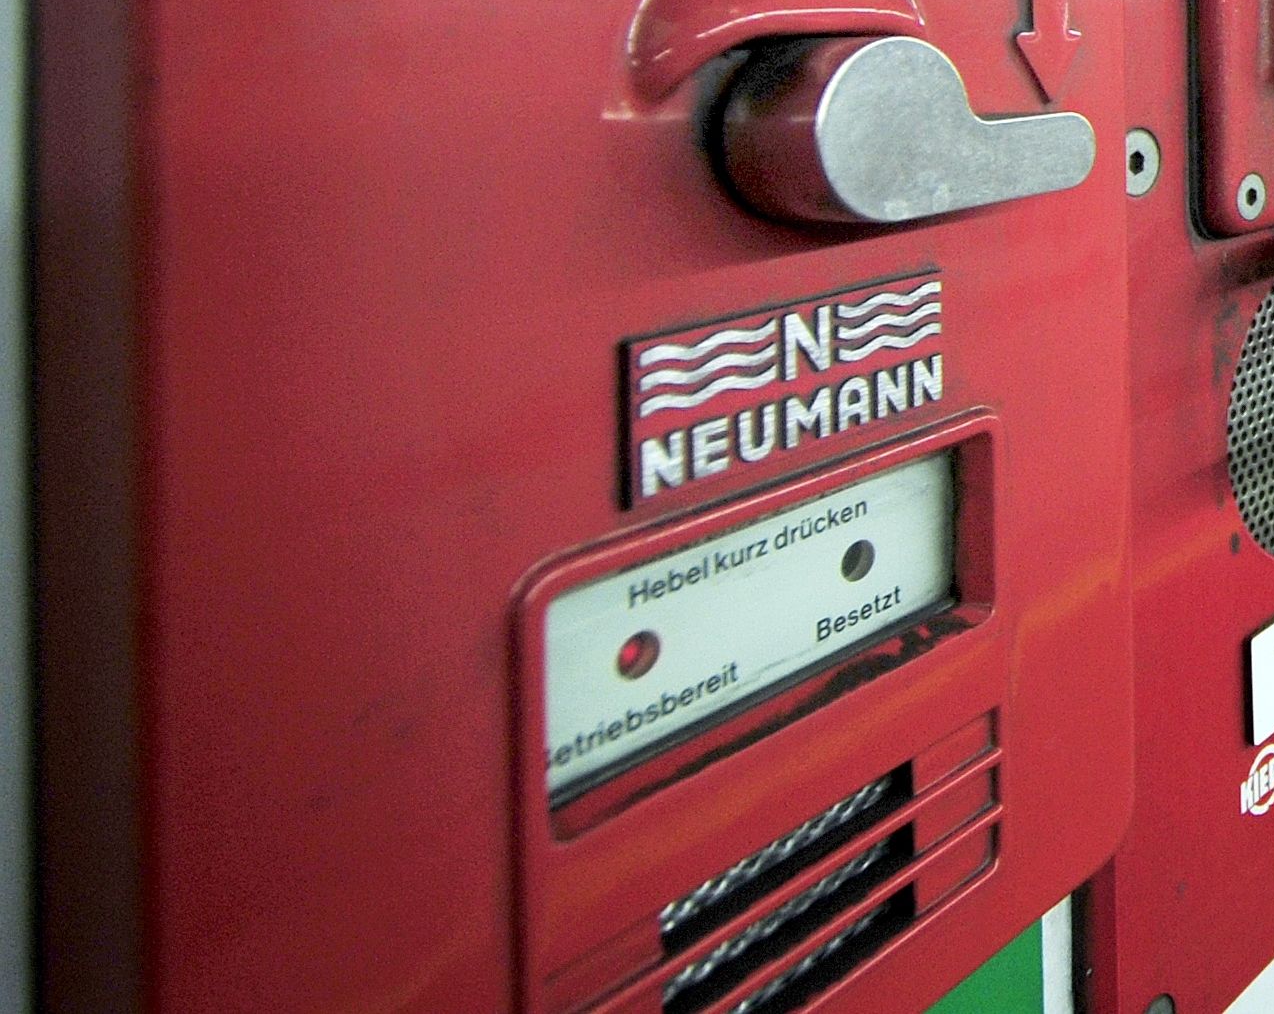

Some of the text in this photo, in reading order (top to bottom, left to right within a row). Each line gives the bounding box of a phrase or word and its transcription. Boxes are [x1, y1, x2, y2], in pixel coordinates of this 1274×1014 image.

[640, 354, 943, 498] NEUMANN
[626, 499, 868, 609] Hebel kurz drücken
[814, 585, 902, 643] Besetzt
[547, 661, 739, 767] etriebsbereit
